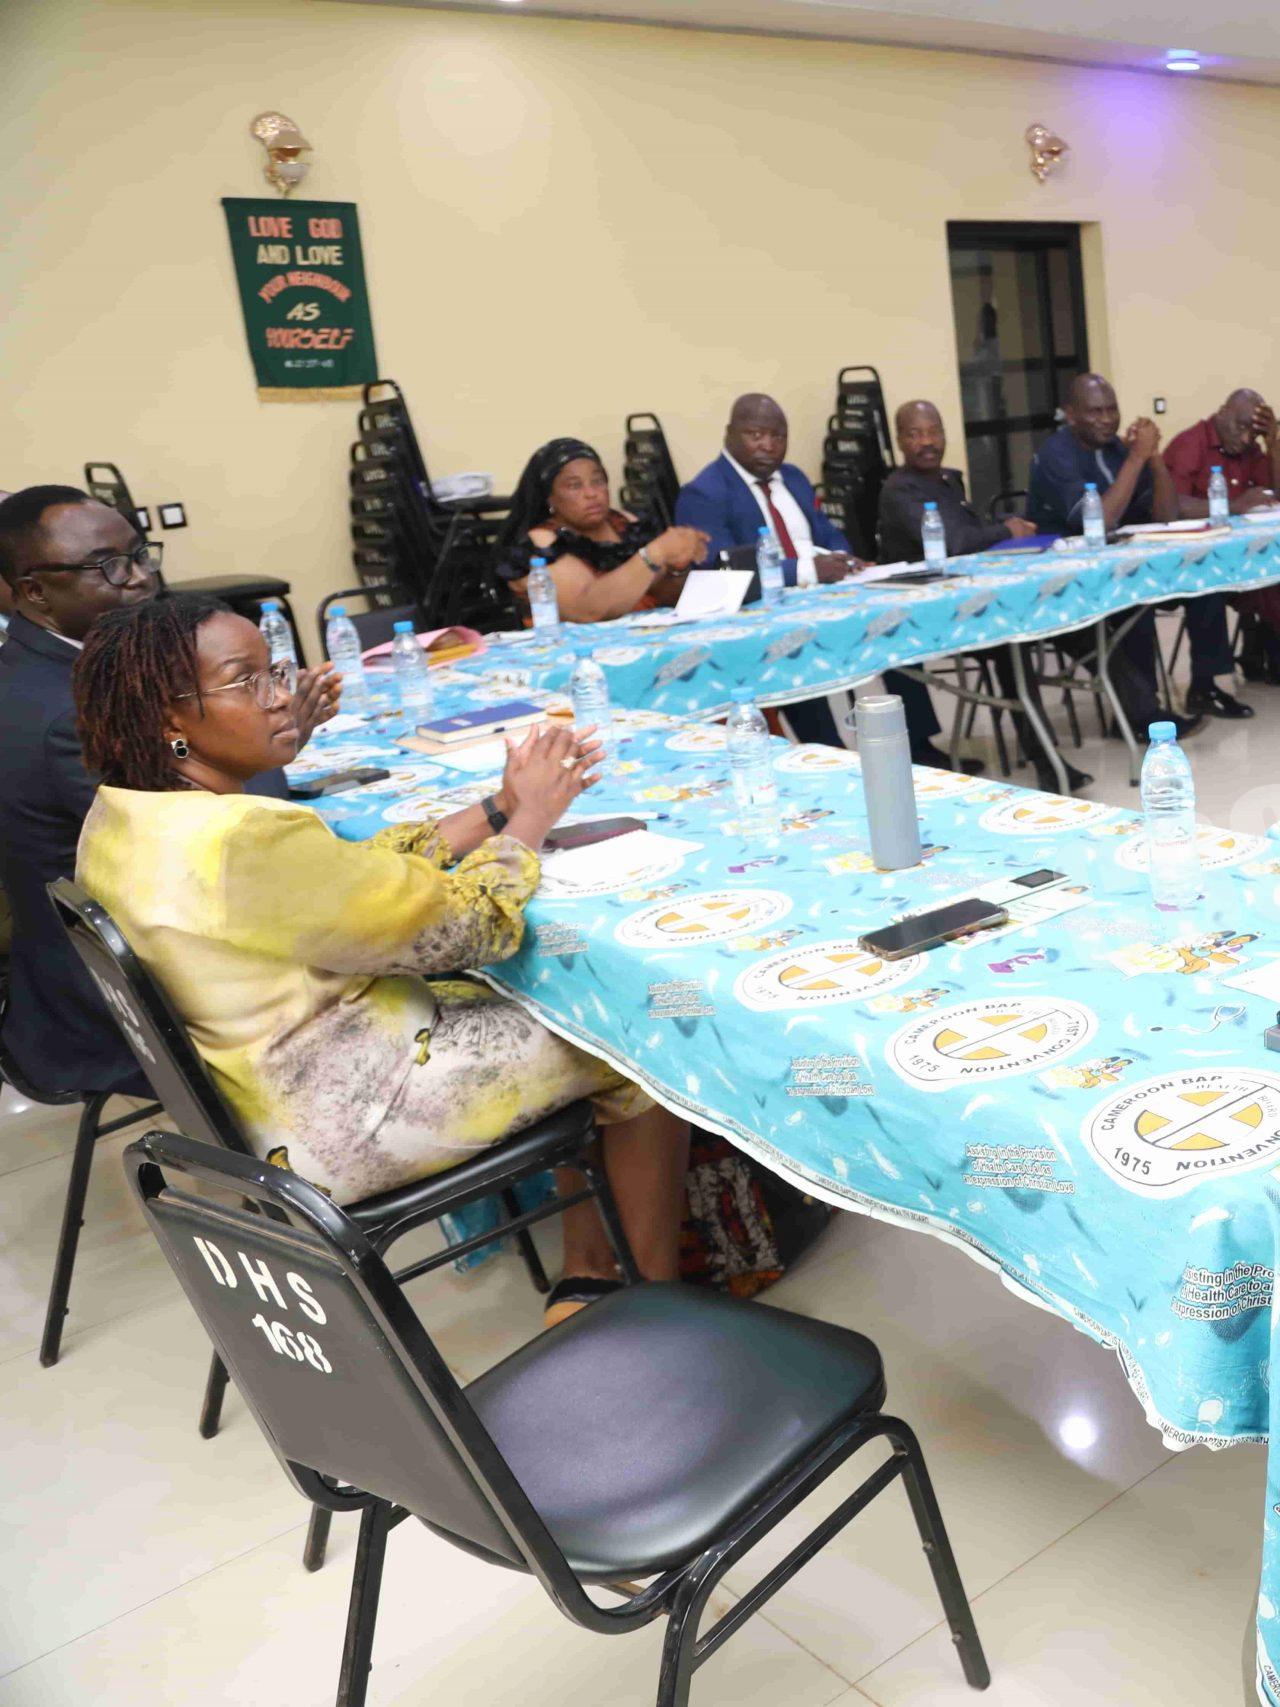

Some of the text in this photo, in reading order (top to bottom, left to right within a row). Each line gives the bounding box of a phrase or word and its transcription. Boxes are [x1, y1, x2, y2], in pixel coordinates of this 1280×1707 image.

[247, 216, 343, 239] LOVE GOD
[257, 244, 343, 265] AND LOVE
[286, 302, 321, 320] AS
[266, 327, 354, 349] YOURSELF
[904, 1006, 978, 1046] CAMEROON
[908, 1053, 941, 1073] 1975
[960, 1037, 1071, 1075] CONVENTION
[1100, 1075, 1223, 1132] CAMEROON BAP
[1113, 1147, 1152, 1176] 1975
[193, 1236, 327, 1326] DHS
[1225, 1271, 1234, 1282] in
[1235, 1263, 1250, 1277] the
[1188, 1286, 1225, 1301] Health
[1228, 1283, 1246, 1299] Care
[1249, 1280, 1260, 1291] to
[251, 1313, 333, 1374] 168
